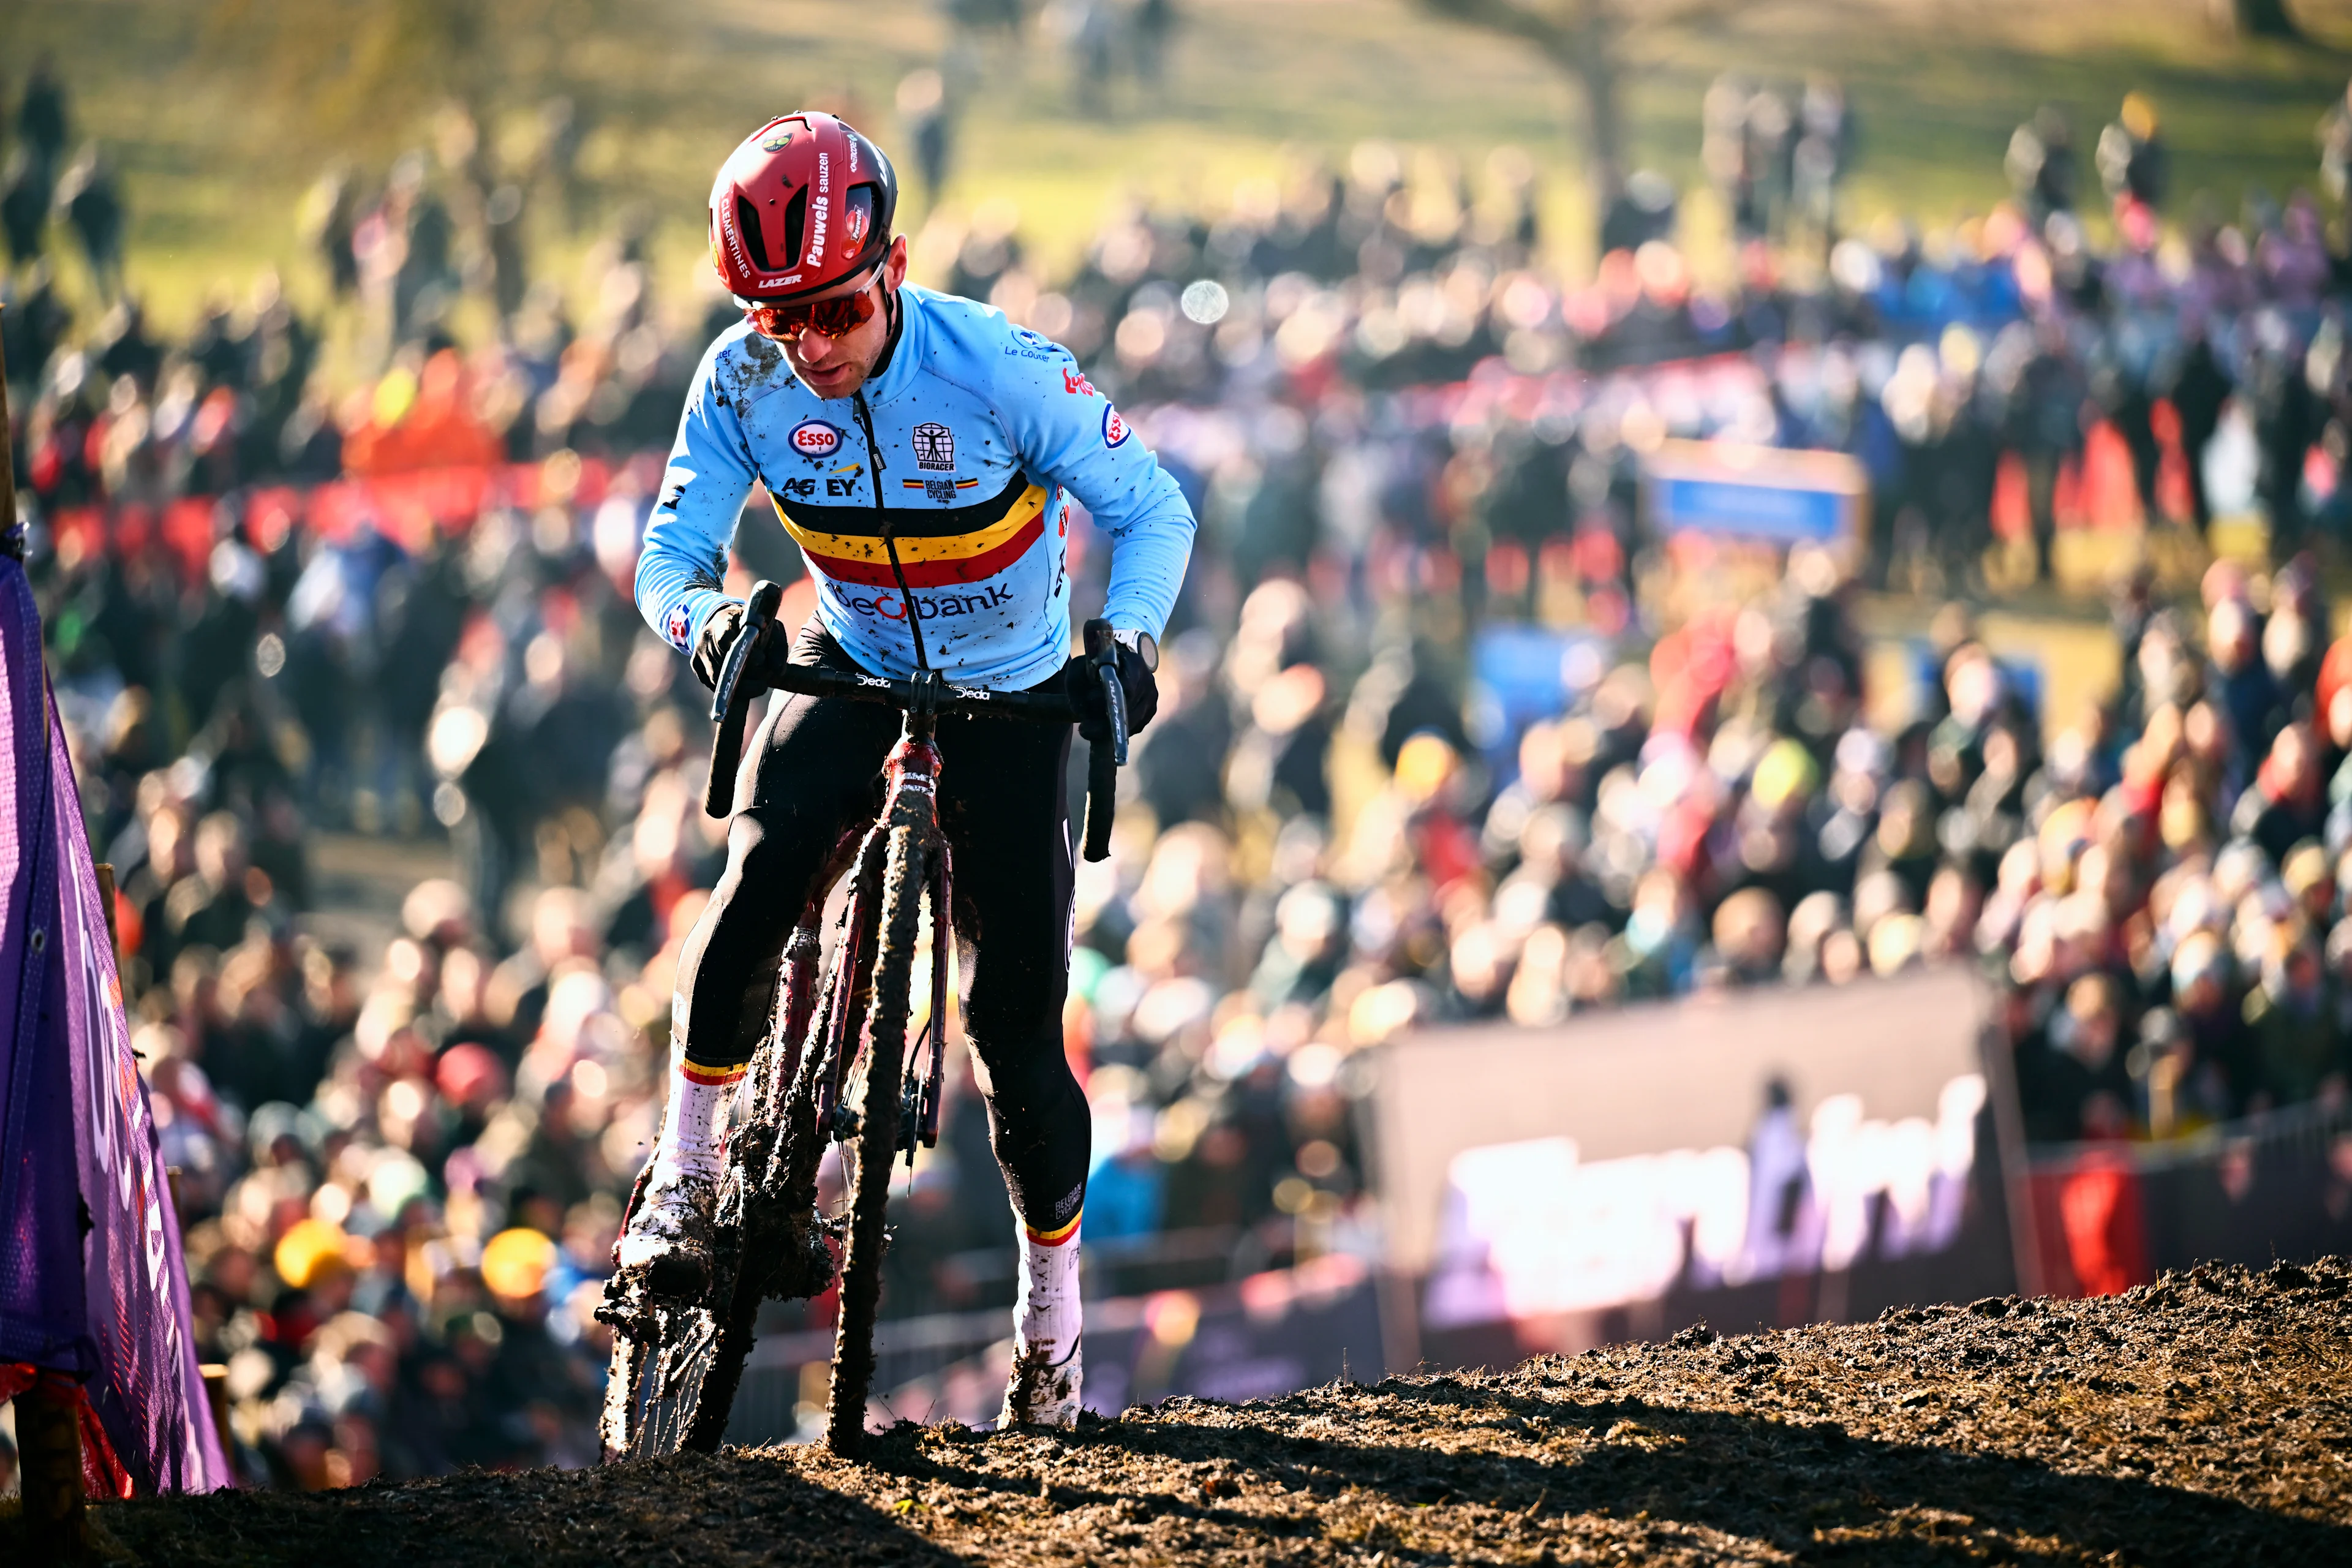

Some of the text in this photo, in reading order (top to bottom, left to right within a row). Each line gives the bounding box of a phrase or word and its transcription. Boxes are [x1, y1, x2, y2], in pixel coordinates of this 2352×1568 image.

[807, 153, 829, 268] Pauwels sauzen
[852, 209, 862, 239] Pauwels
[721, 197, 750, 279] CLEMENTINES
[758, 274, 802, 289] LAZER
[1005, 346, 1018, 356] Le
[797, 430, 834, 446] Esso
[919, 462, 954, 471] BIORACER
[781, 478, 816, 495] AG
[826, 479, 856, 496] EY
[925, 479, 954, 489] BELGIAN
[927, 490, 956, 499] CYCLING
[855, 673, 891, 688] Deda
[953, 687, 990, 701] Deda
[1109, 680, 1122, 744] DURA-ACE
[1055, 1182, 1082, 1212] BELGIAN
